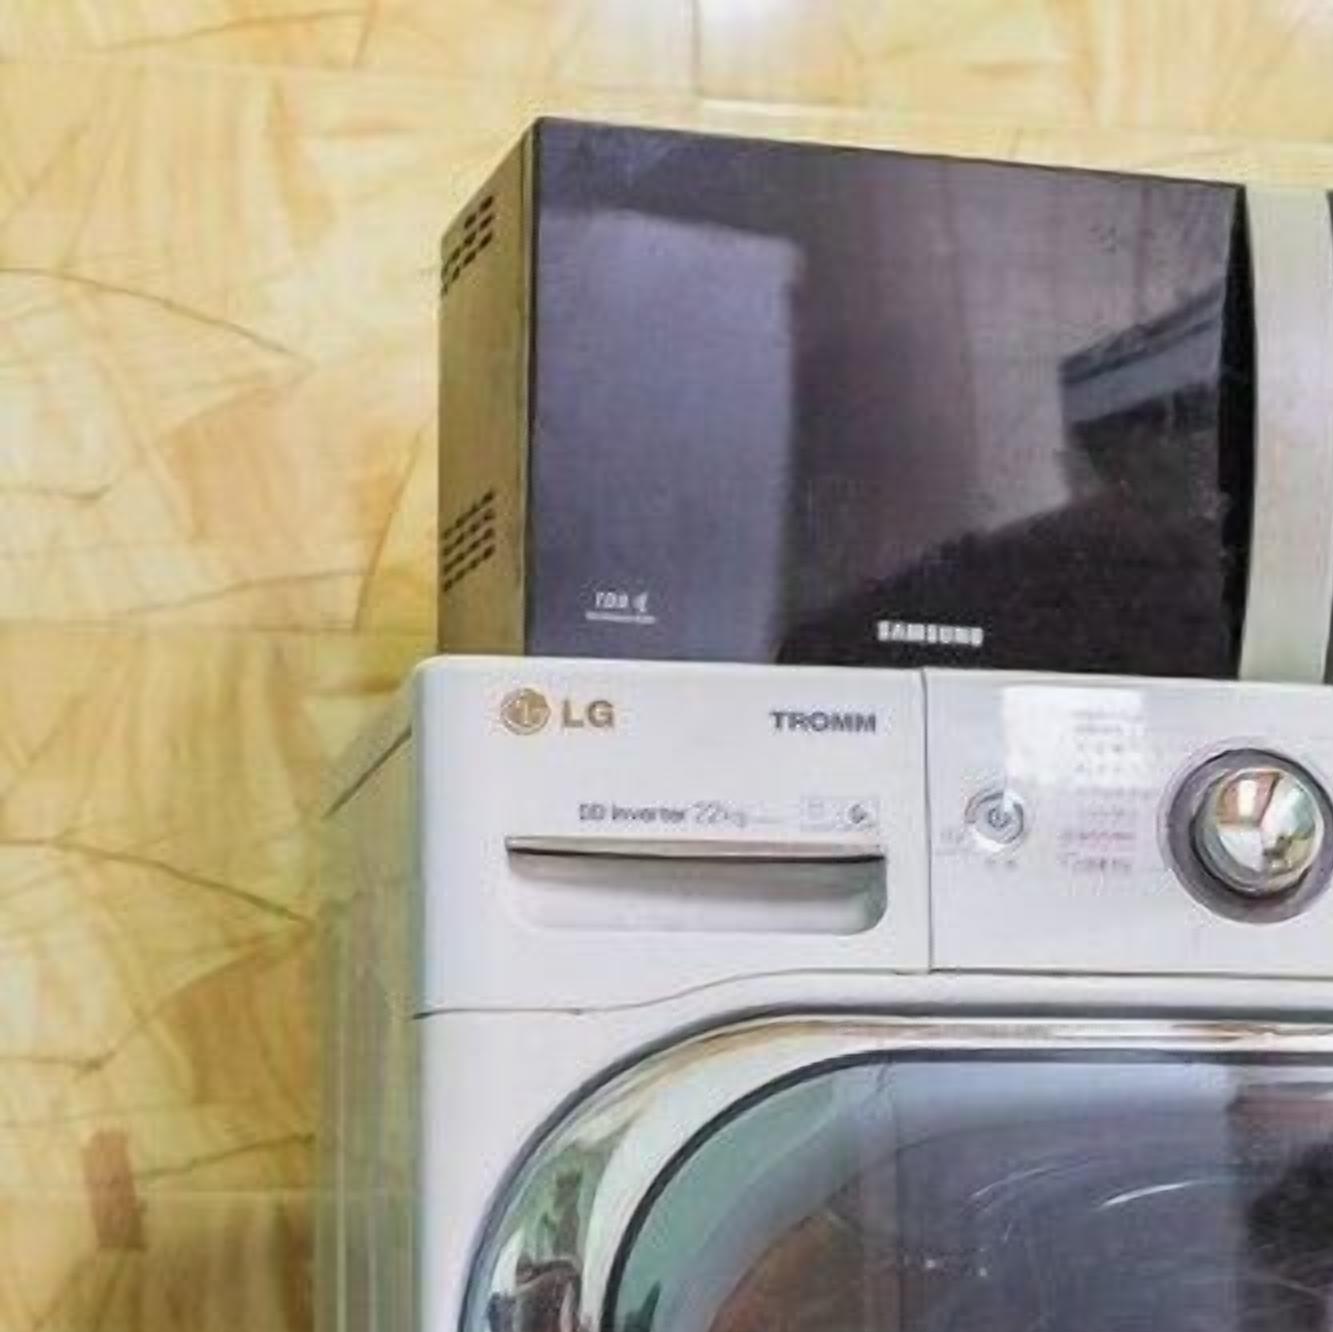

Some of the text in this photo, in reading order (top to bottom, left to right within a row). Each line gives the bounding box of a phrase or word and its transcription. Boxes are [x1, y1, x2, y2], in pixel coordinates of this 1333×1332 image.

[878, 620, 983, 647] SAMSUNG
[562, 699, 615, 728] LG
[769, 711, 876, 732] TROMM
